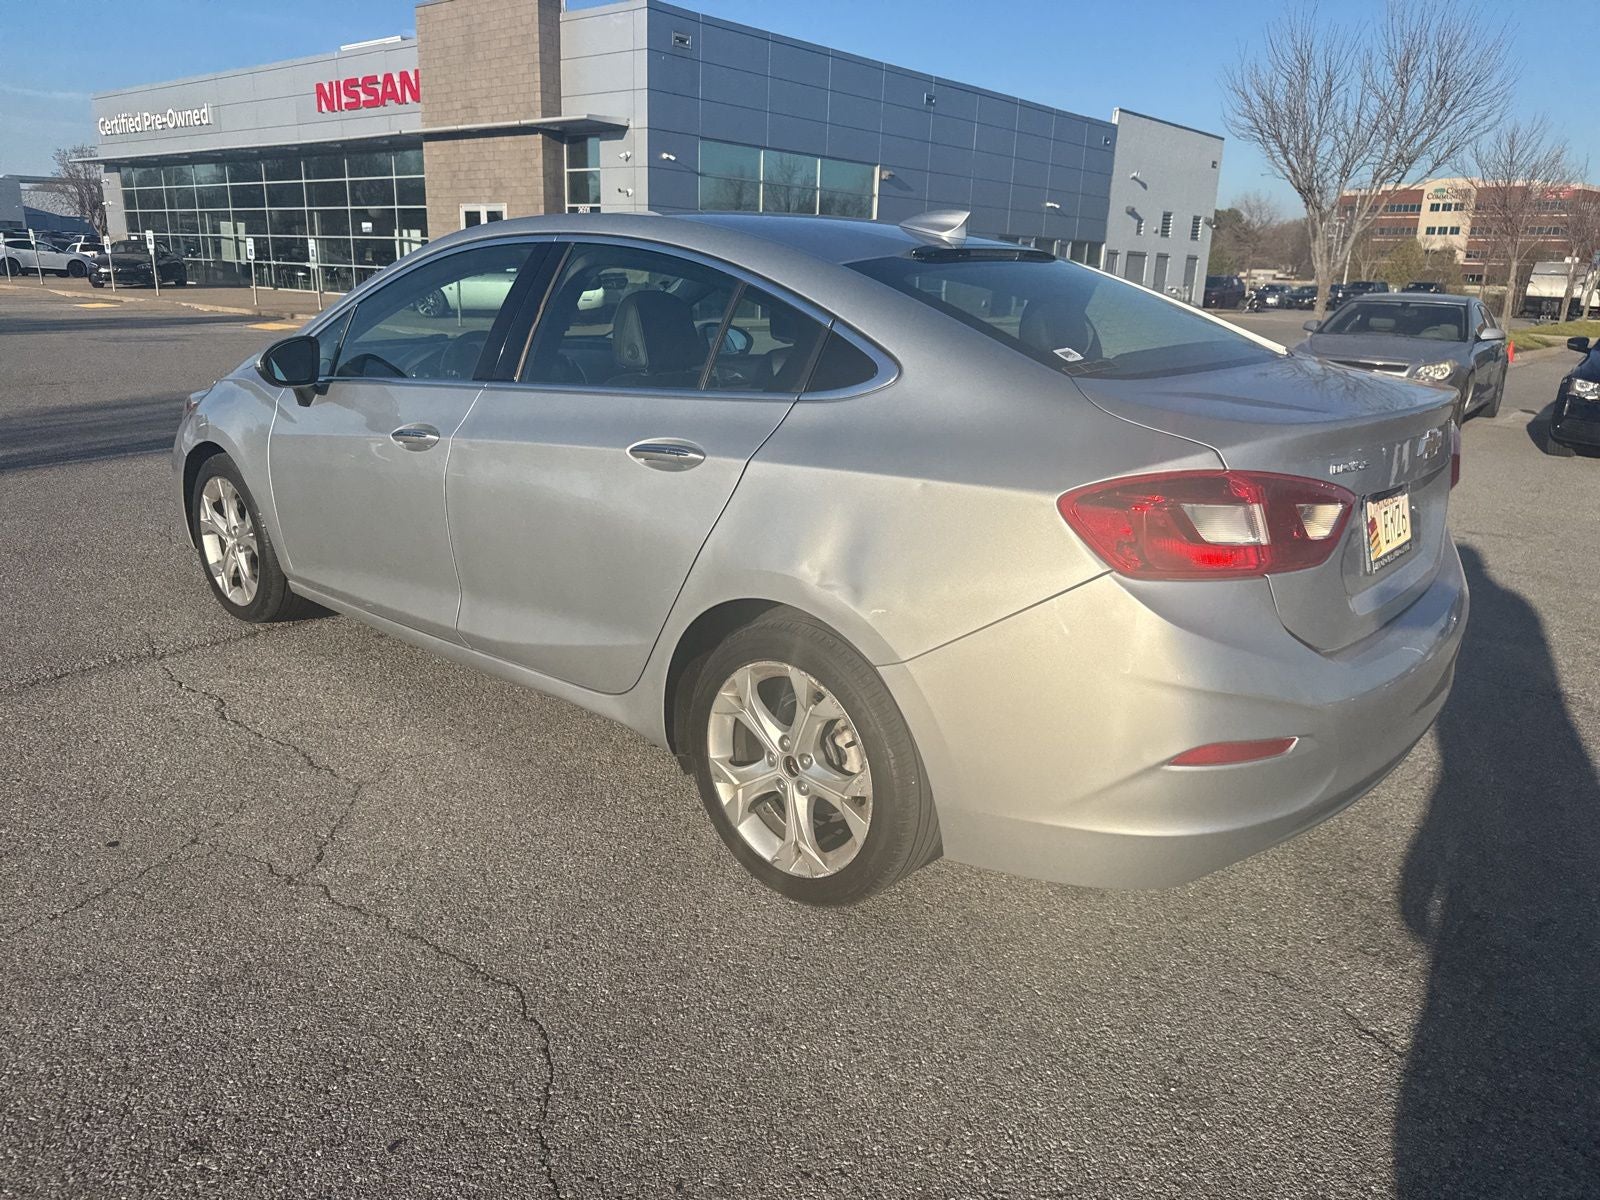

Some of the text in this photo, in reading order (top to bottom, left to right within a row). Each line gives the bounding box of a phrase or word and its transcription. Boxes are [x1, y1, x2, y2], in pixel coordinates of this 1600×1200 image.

[315, 69, 421, 112] NISSAN
[99, 103, 209, 136] Certified Pre-Owned
